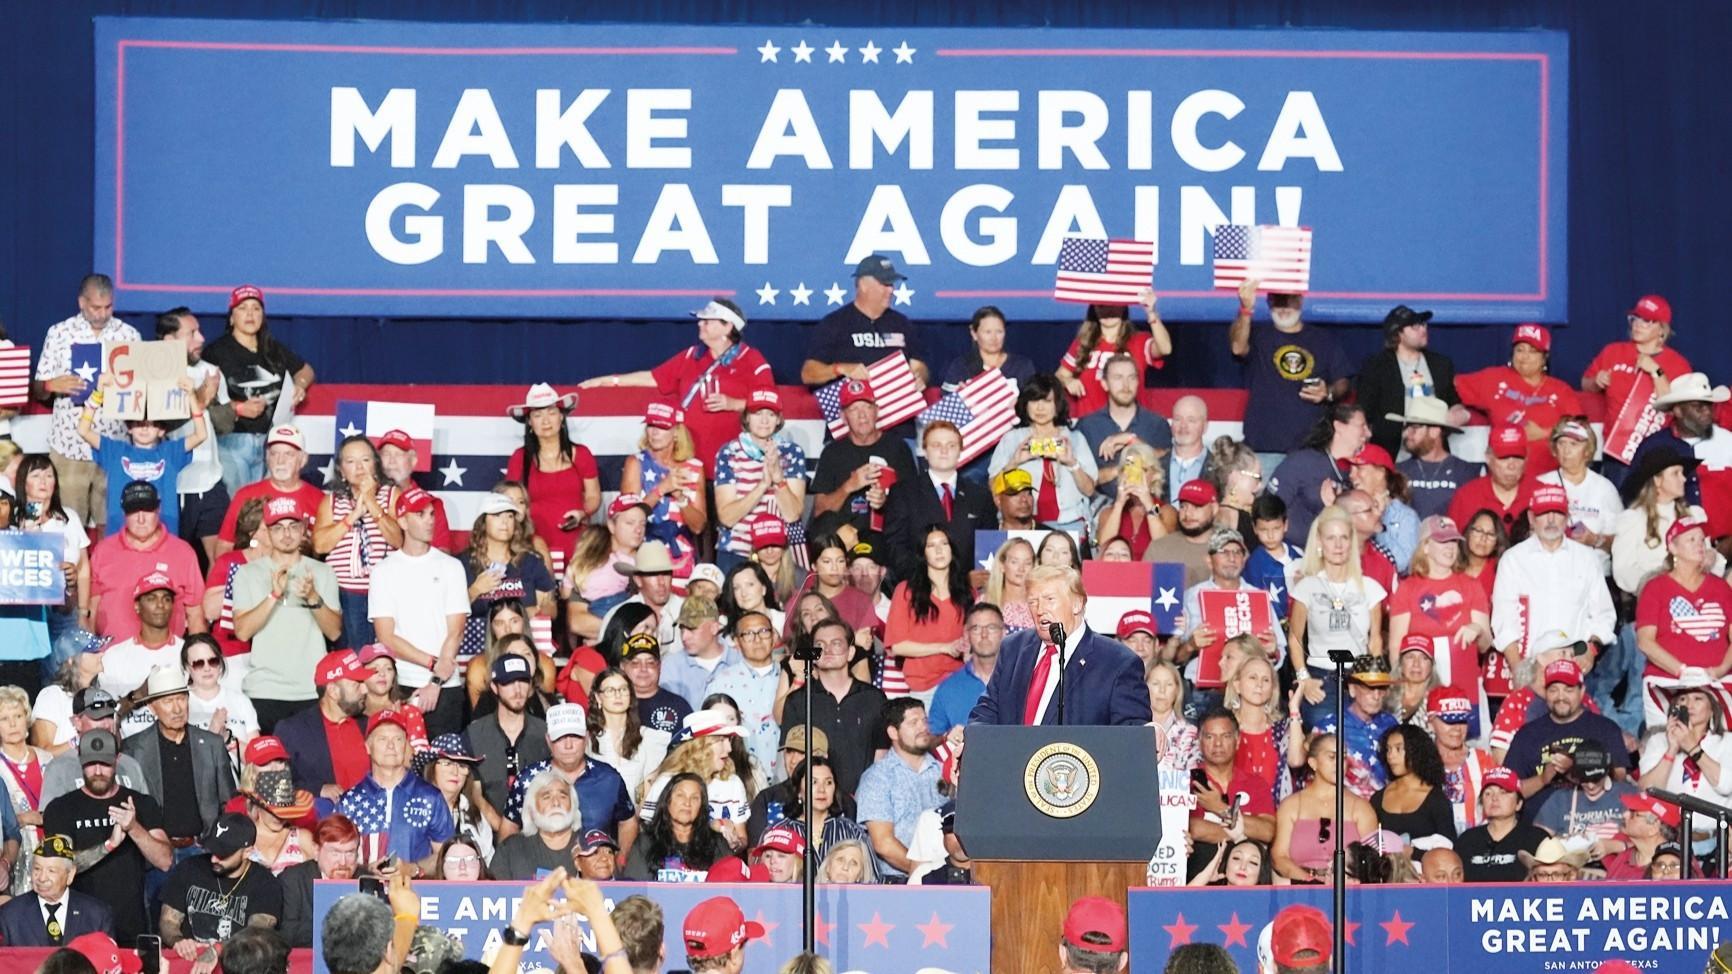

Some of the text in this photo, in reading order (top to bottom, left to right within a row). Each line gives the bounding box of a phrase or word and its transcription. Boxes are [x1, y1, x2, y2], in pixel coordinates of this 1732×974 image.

[330, 87, 1344, 172] MAKE AMERICA
[365, 183, 792, 264] GREAT
[852, 332, 885, 348] USA
[0, 549, 54, 569] WER
[1, 569, 53, 588] ICES
[1224, 606, 1239, 639] GER
[1160, 795, 1196, 806] LICAN
[1149, 863, 1177, 874] OTS
[1471, 896, 1729, 923] MAKE AMERICA
[1482, 927, 1720, 953] GREAT AGAIN!
[1544, 961, 1566, 970] SAN
